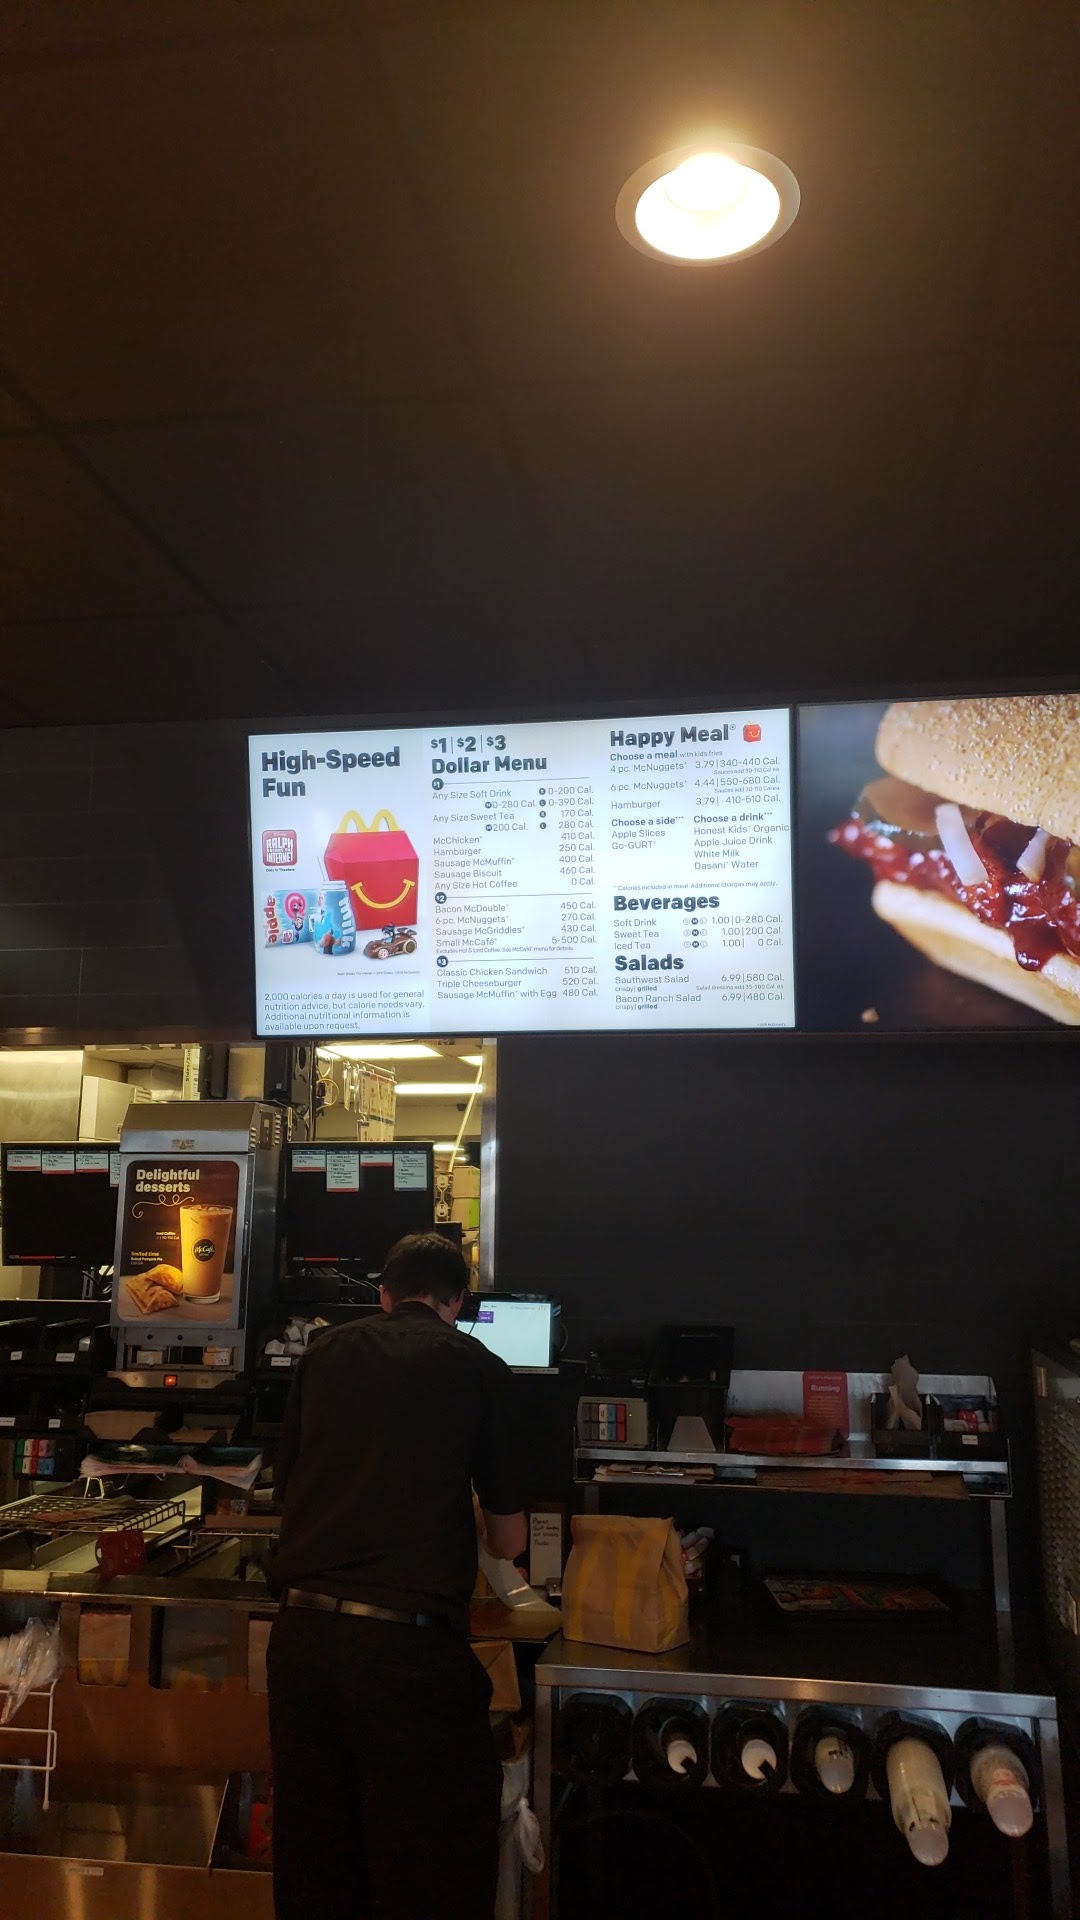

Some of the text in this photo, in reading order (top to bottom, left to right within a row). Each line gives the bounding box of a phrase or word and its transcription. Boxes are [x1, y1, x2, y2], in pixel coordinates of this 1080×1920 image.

[431, 734, 506, 753] $1 $2 $3
[610, 730, 675, 748] Happy
[262, 746, 400, 774] High-Speed
[610, 753, 644, 761] Choose
[655, 751, 678, 759] meal
[432, 756, 547, 774] Dollar Menu
[263, 778, 306, 797] Fun
[432, 792, 448, 801] Any
[611, 794, 780, 810] Hamburger Cal.
[433, 815, 448, 823] Any
[611, 818, 647, 826] Choose
[694, 815, 729, 823] Choose
[694, 827, 726, 835] Honest
[753, 824, 789, 833] Organic
[612, 831, 637, 839] Apple
[266, 837, 293, 849] RALPH
[694, 836, 772, 848] Apple Juice Drink
[434, 848, 482, 856] Hamburger
[434, 859, 470, 868] Sausage
[731, 860, 759, 869] Water
[434, 871, 471, 879] Sausage
[434, 882, 450, 890] Any
[614, 896, 720, 912] Beverages
[264, 896, 279, 943] apple
[614, 916, 729, 927] Soft Drink 1.00
[436, 928, 472, 936] Sausage
[614, 930, 641, 938] Sweet
[643, 930, 659, 938] Tea
[614, 942, 632, 950] Iced
[615, 954, 684, 971] Salads
[469, 968, 503, 976] Chicken
[506, 967, 547, 976] Sandwich
[438, 980, 460, 989] Triple
[462, 980, 521, 988] Cheeseburger
[615, 975, 689, 984] Southwest Salad
[265, 993, 288, 1001] 2,000
[291, 992, 322, 1000] calories
[332, 991, 346, 1001] day
[358, 991, 378, 999] used
[394, 990, 424, 999] general
[438, 992, 474, 1000] Sausage
[540, 990, 556, 998] Egg
[616, 994, 643, 1002] Bacon
[676, 993, 701, 1001] Salad
[767, 992, 784, 1000] Cal.
[265, 1002, 299, 1011] nutrition
[301, 1002, 330, 1010] advice,
[265, 1011, 401, 1021] Additional nutritional information
[265, 1022, 301, 1031] available
[326, 1022, 360, 1030] request.
[137, 1169, 200, 1182] Delightful
[136, 1182, 191, 1192] desserts
